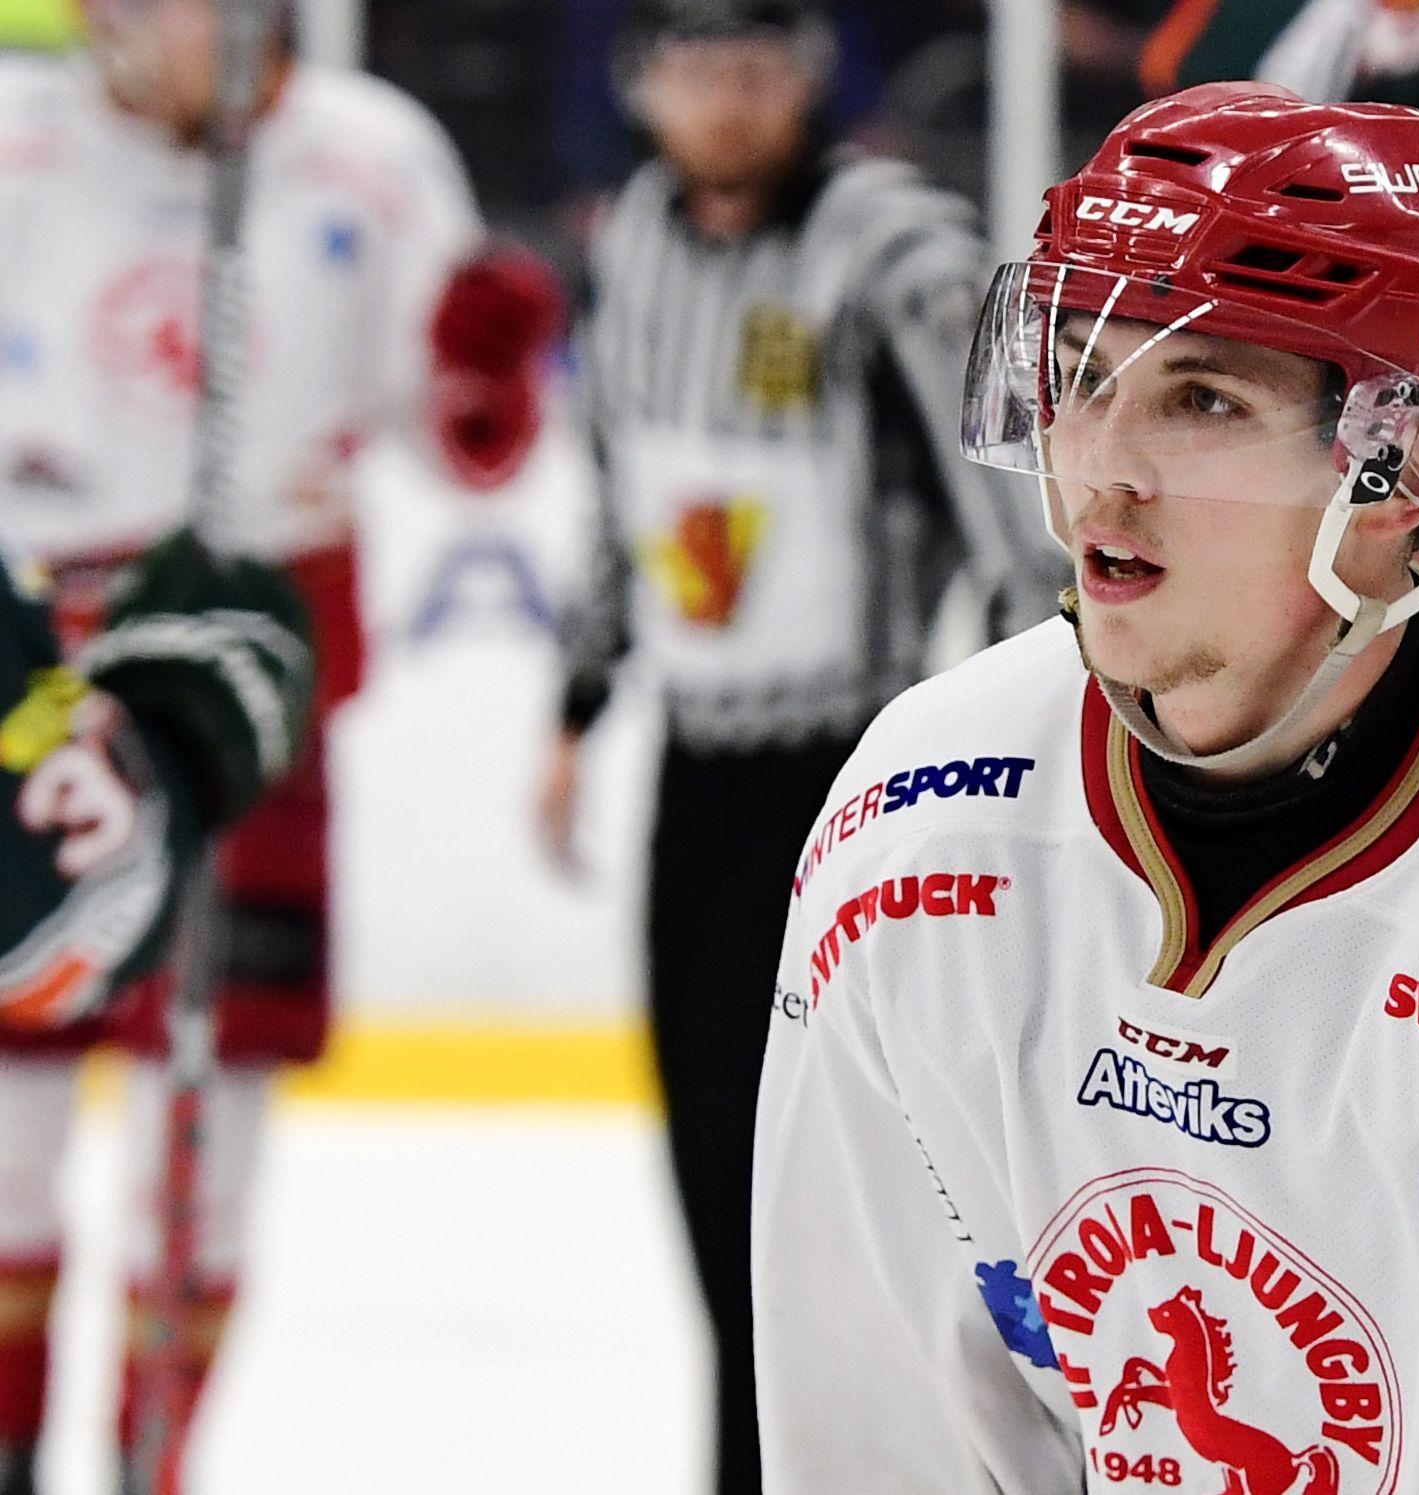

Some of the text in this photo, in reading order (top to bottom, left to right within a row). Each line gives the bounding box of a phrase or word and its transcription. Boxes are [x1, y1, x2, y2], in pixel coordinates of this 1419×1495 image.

[1076, 195, 1200, 235] CCM
[1117, 1015, 1230, 1068] CCM
[1077, 1047, 1271, 1148] Atteviks
